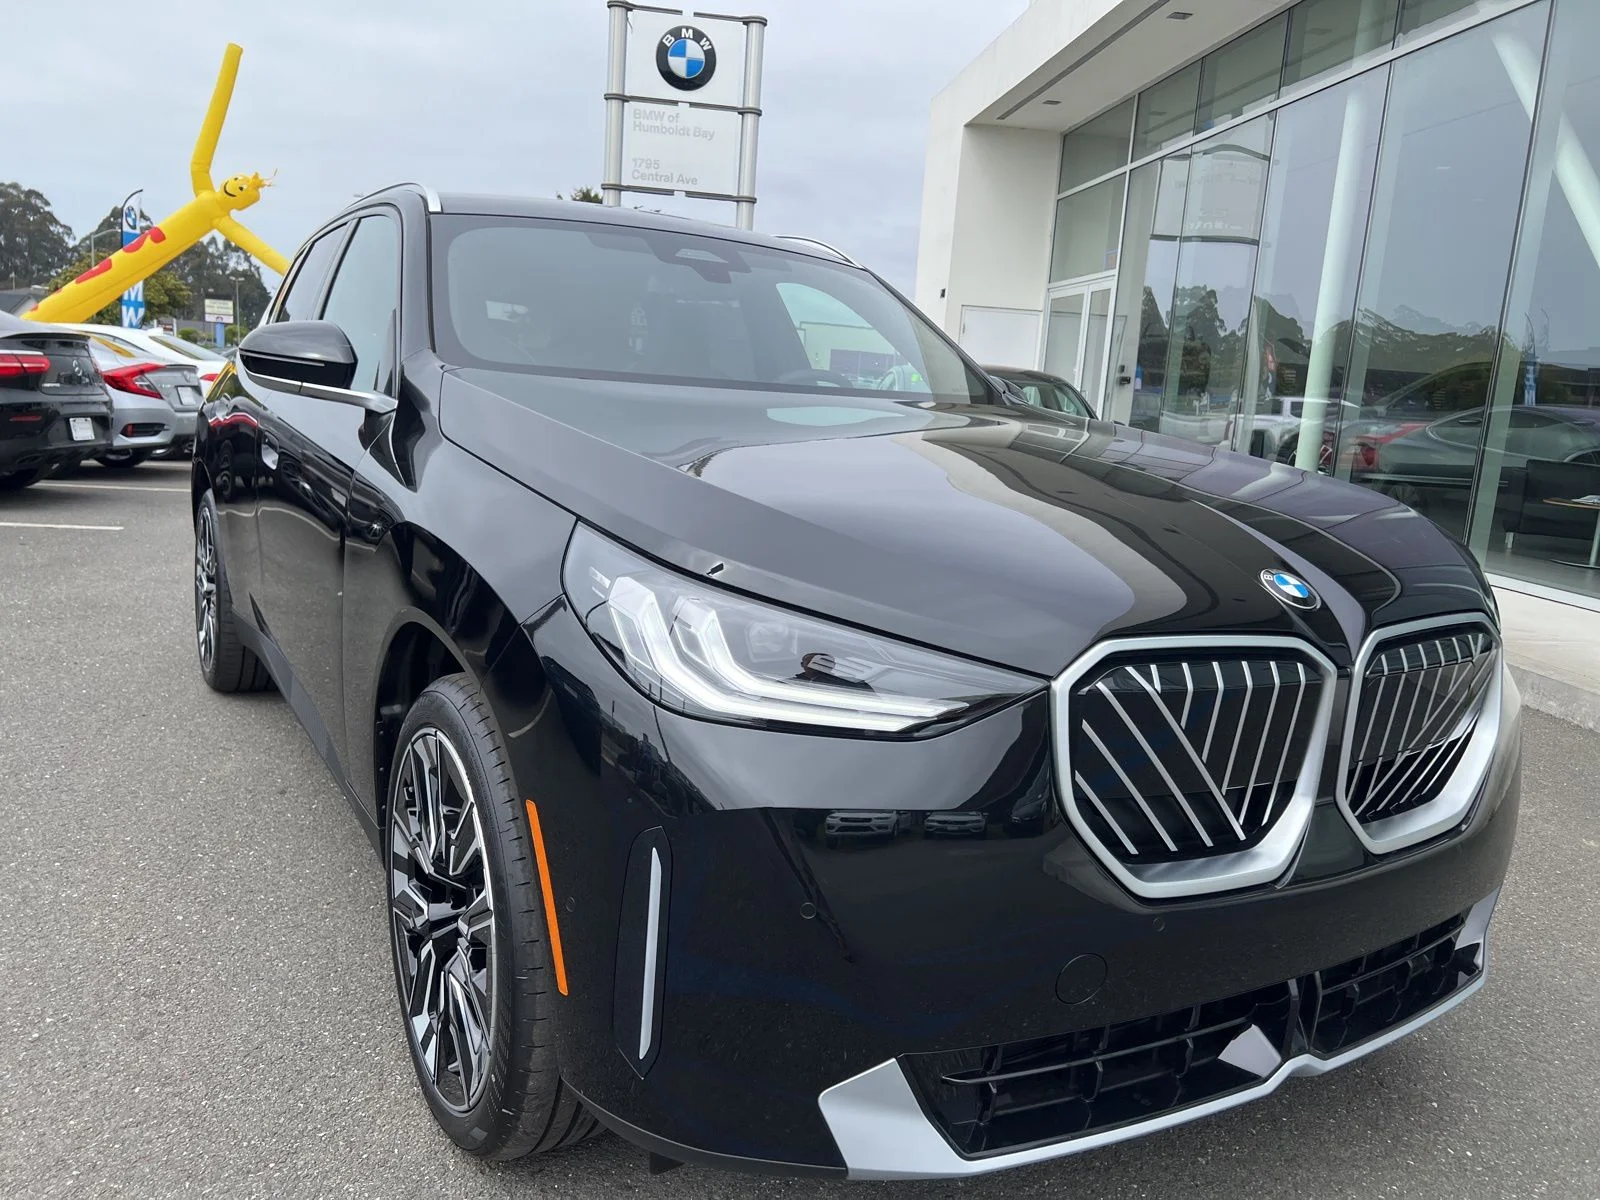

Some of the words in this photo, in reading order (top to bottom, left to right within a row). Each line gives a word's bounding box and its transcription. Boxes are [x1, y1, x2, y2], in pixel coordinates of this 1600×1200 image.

[662, 28, 712, 52] BMW
[633, 108, 665, 122] BMW
[667, 112, 680, 124] of
[633, 120, 690, 137] Humboldt
[693, 126, 716, 142] Bay
[631, 157, 660, 170] 1795
[631, 168, 673, 183] Central
[676, 173, 698, 186] Ave
